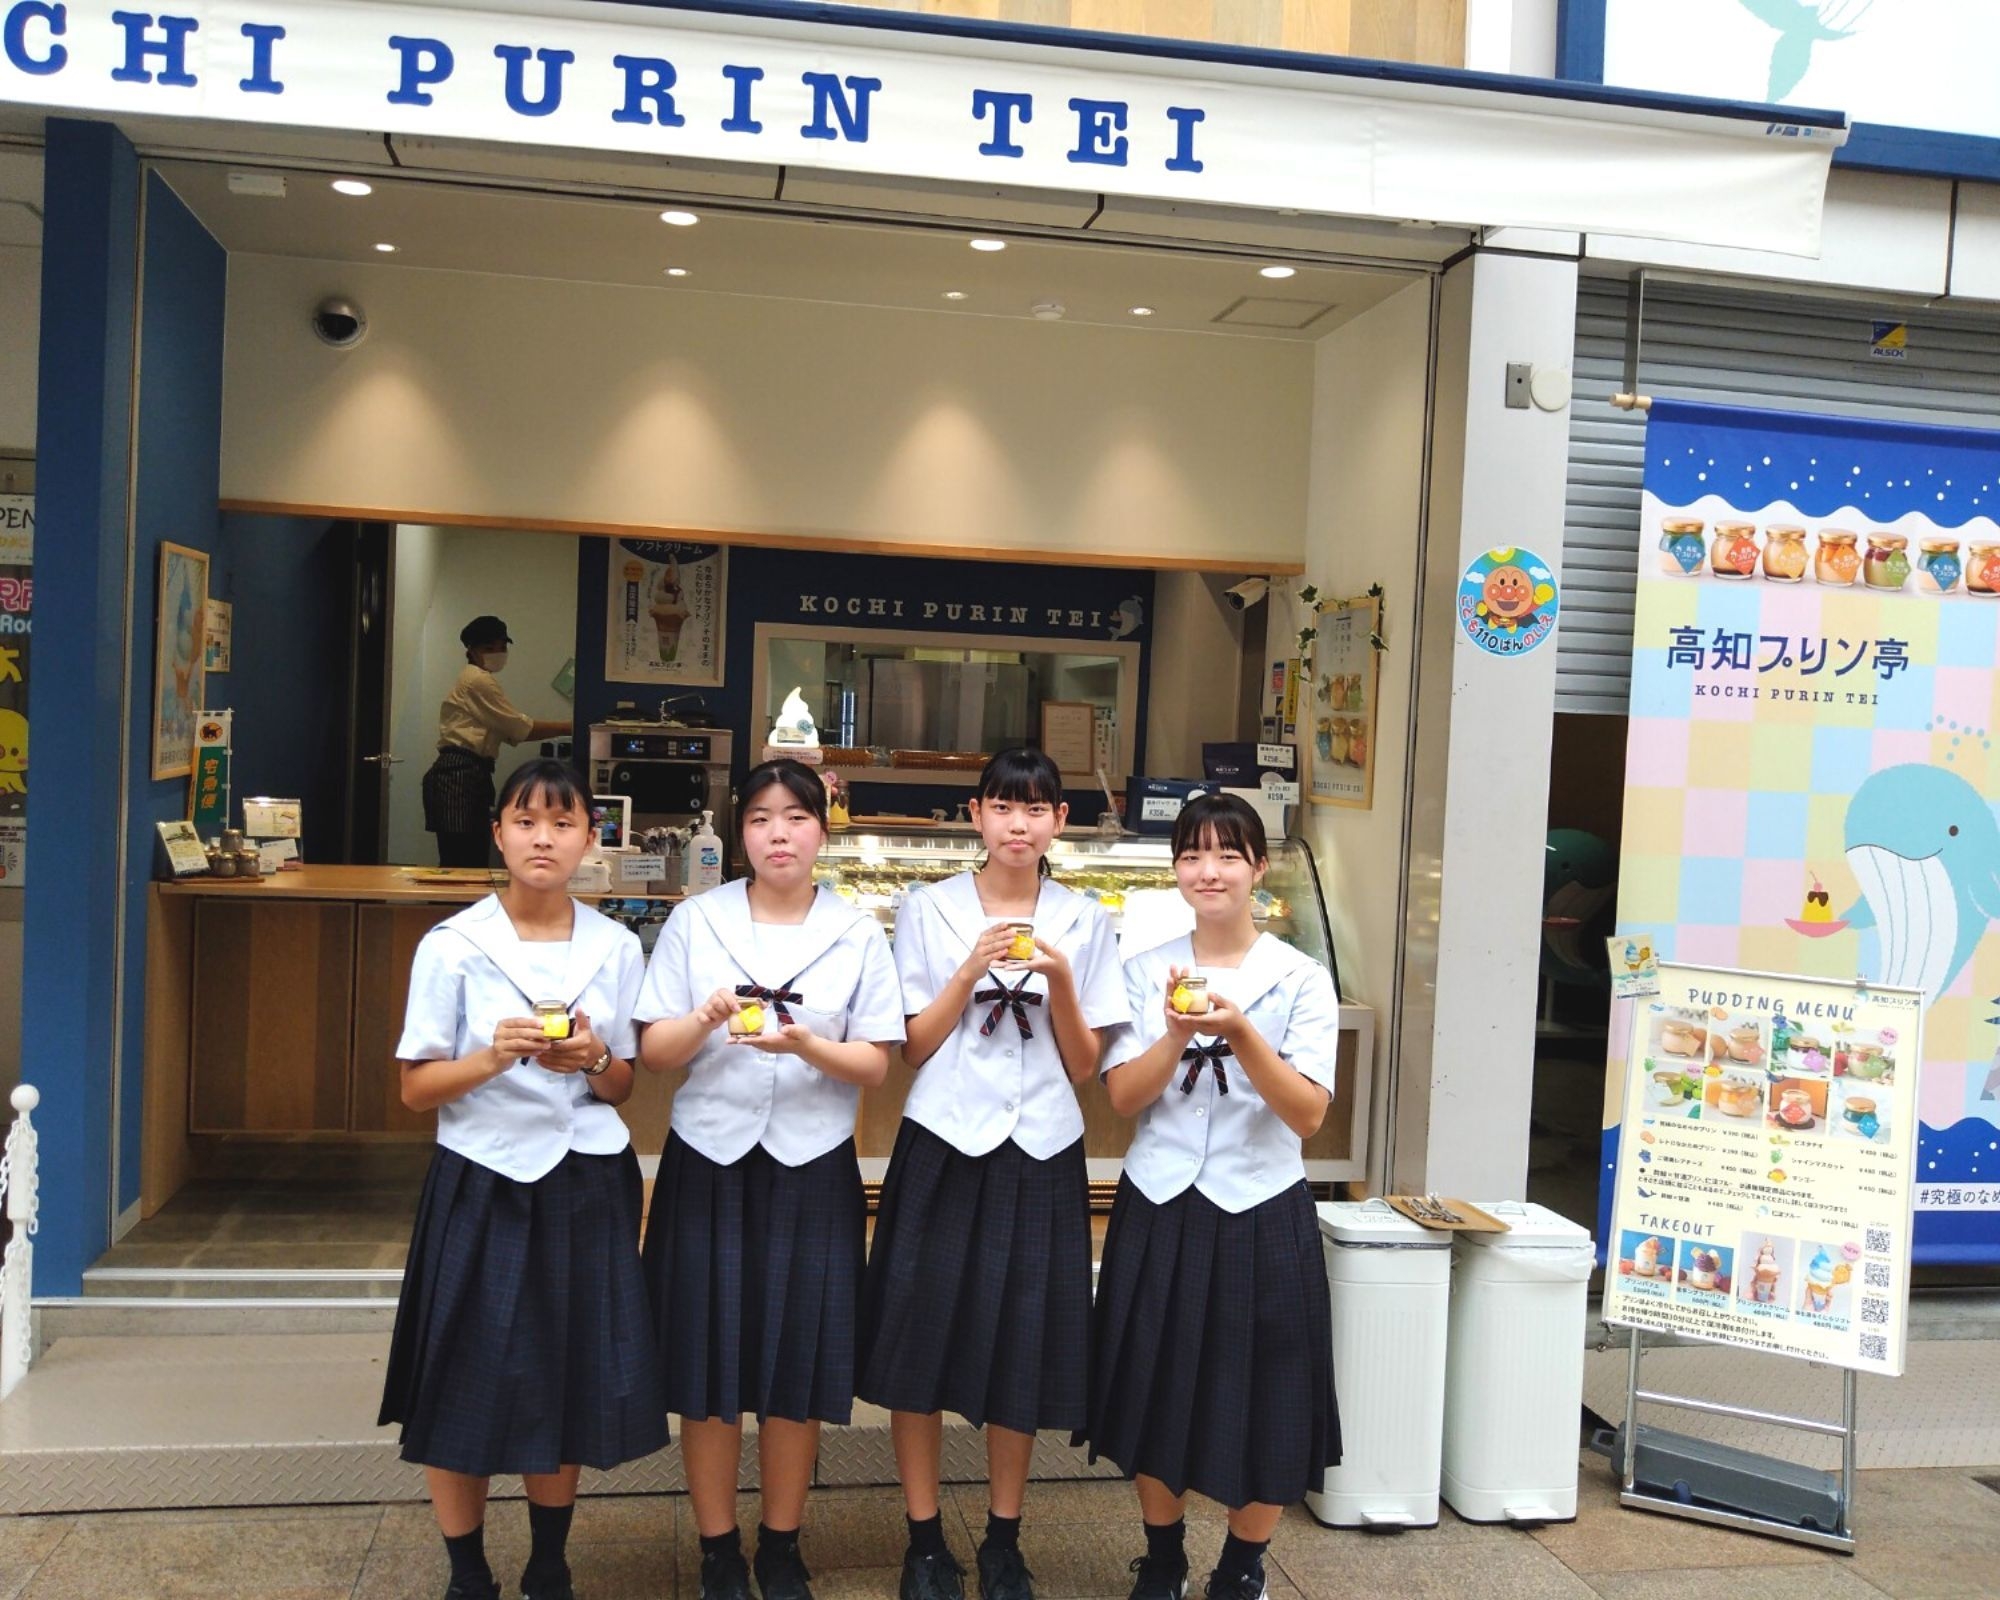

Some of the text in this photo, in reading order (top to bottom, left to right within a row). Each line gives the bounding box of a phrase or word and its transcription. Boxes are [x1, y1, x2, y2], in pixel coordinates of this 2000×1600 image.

[4, 0, 1206, 173] CHI PURIN TEI
[1873, 348, 1905, 358] ALSOK
[800, 595, 1102, 628] KOCHI PURIN TEI
[1666, 626, 1910, 681] 高知プリン亭
[1695, 684, 1880, 706] KOCHI PURIN TEI
[1688, 988, 1853, 1021] PUDDING MENU
[1639, 1213, 1716, 1237] TAKEOUT
